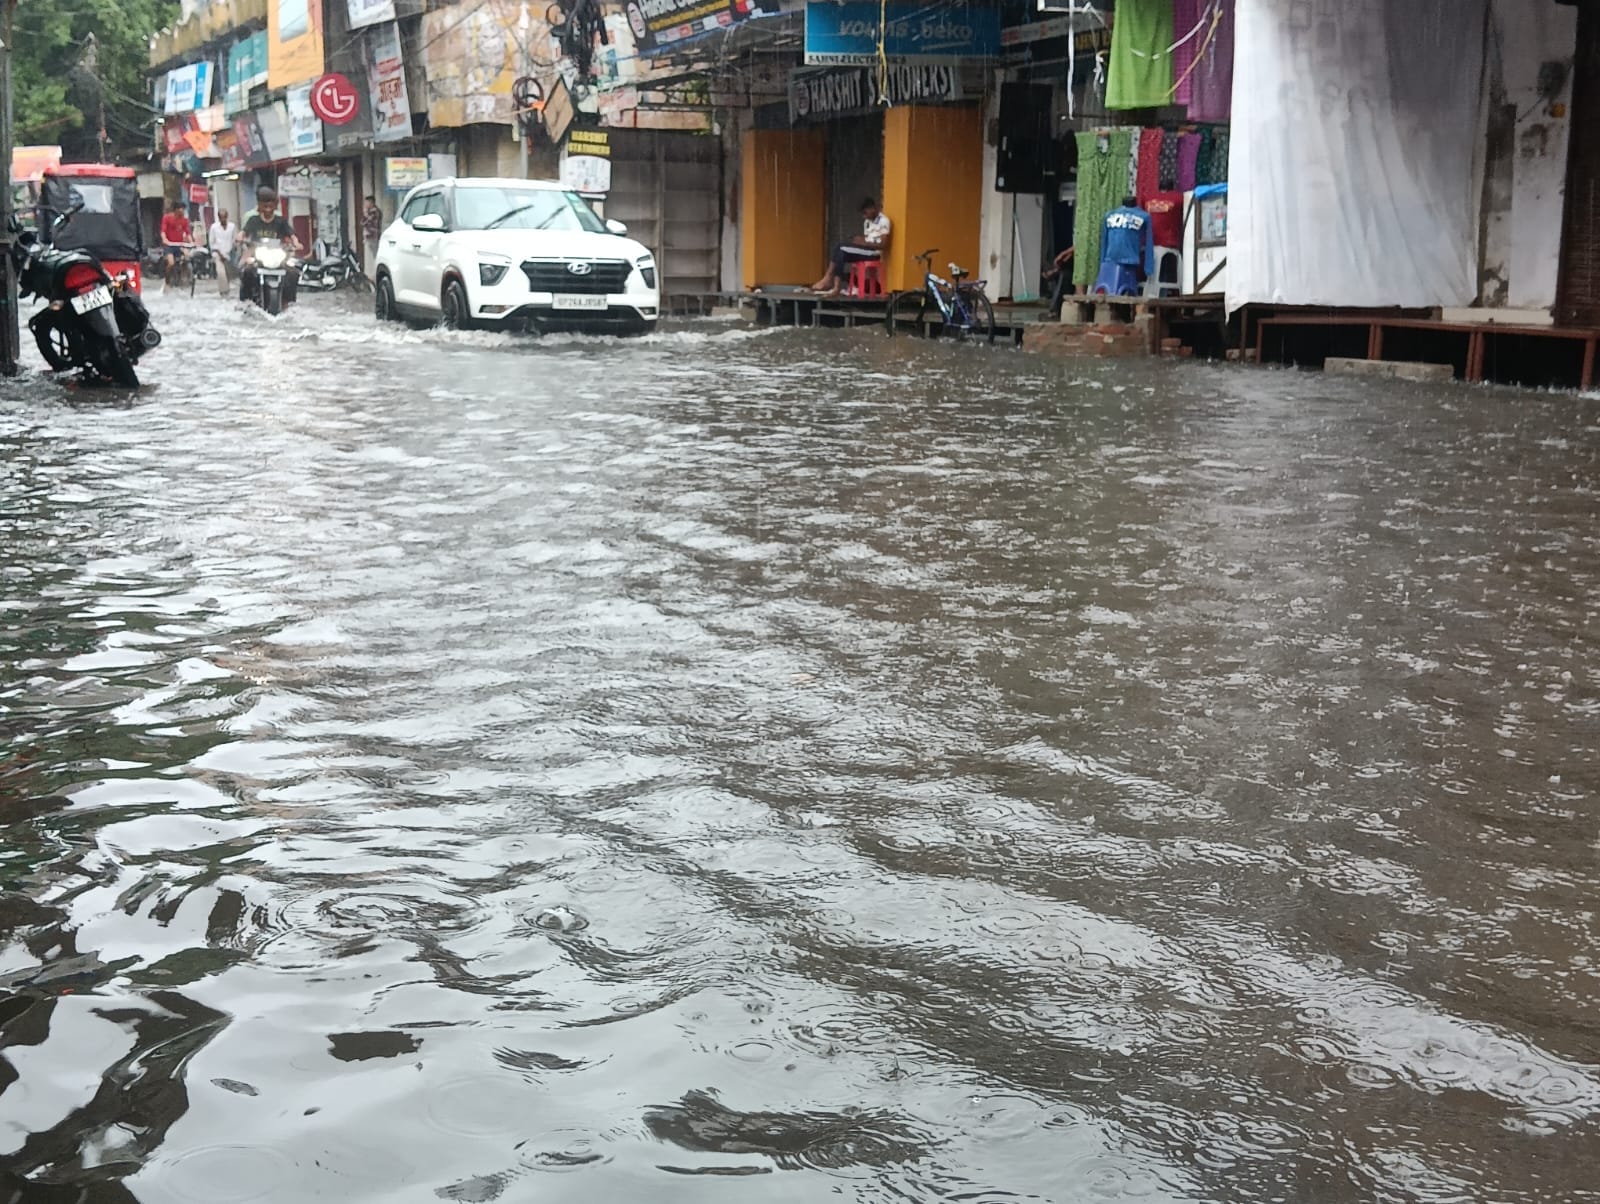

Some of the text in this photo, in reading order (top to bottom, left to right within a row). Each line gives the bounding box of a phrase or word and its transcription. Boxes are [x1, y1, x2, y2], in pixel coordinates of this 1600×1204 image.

[921, 20, 973, 39] beko
[810, 64, 948, 112] HARSHIT STIONERS
